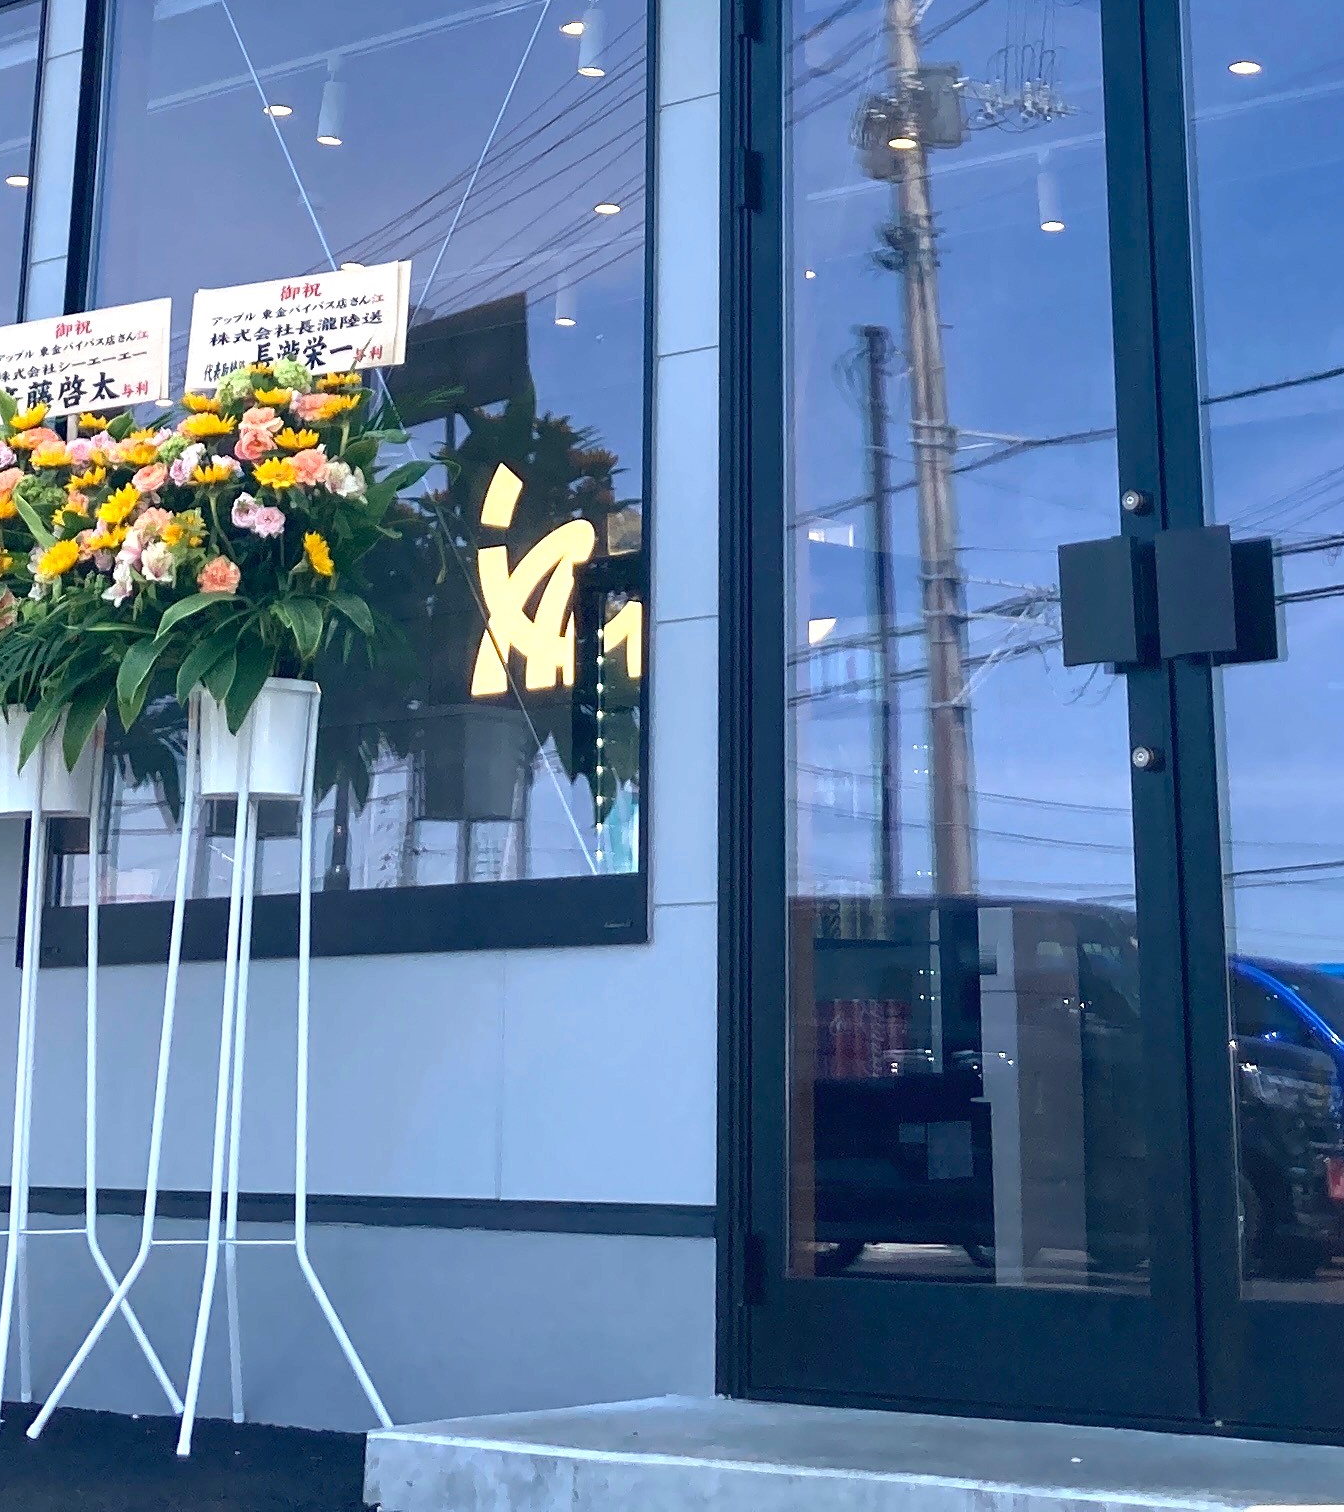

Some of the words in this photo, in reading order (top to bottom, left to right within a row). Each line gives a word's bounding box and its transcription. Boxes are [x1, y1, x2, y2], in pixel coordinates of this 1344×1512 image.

[280, 282, 322, 302] 御祝
[211, 311, 256, 327] アップル
[55, 320, 93, 339] 御祝
